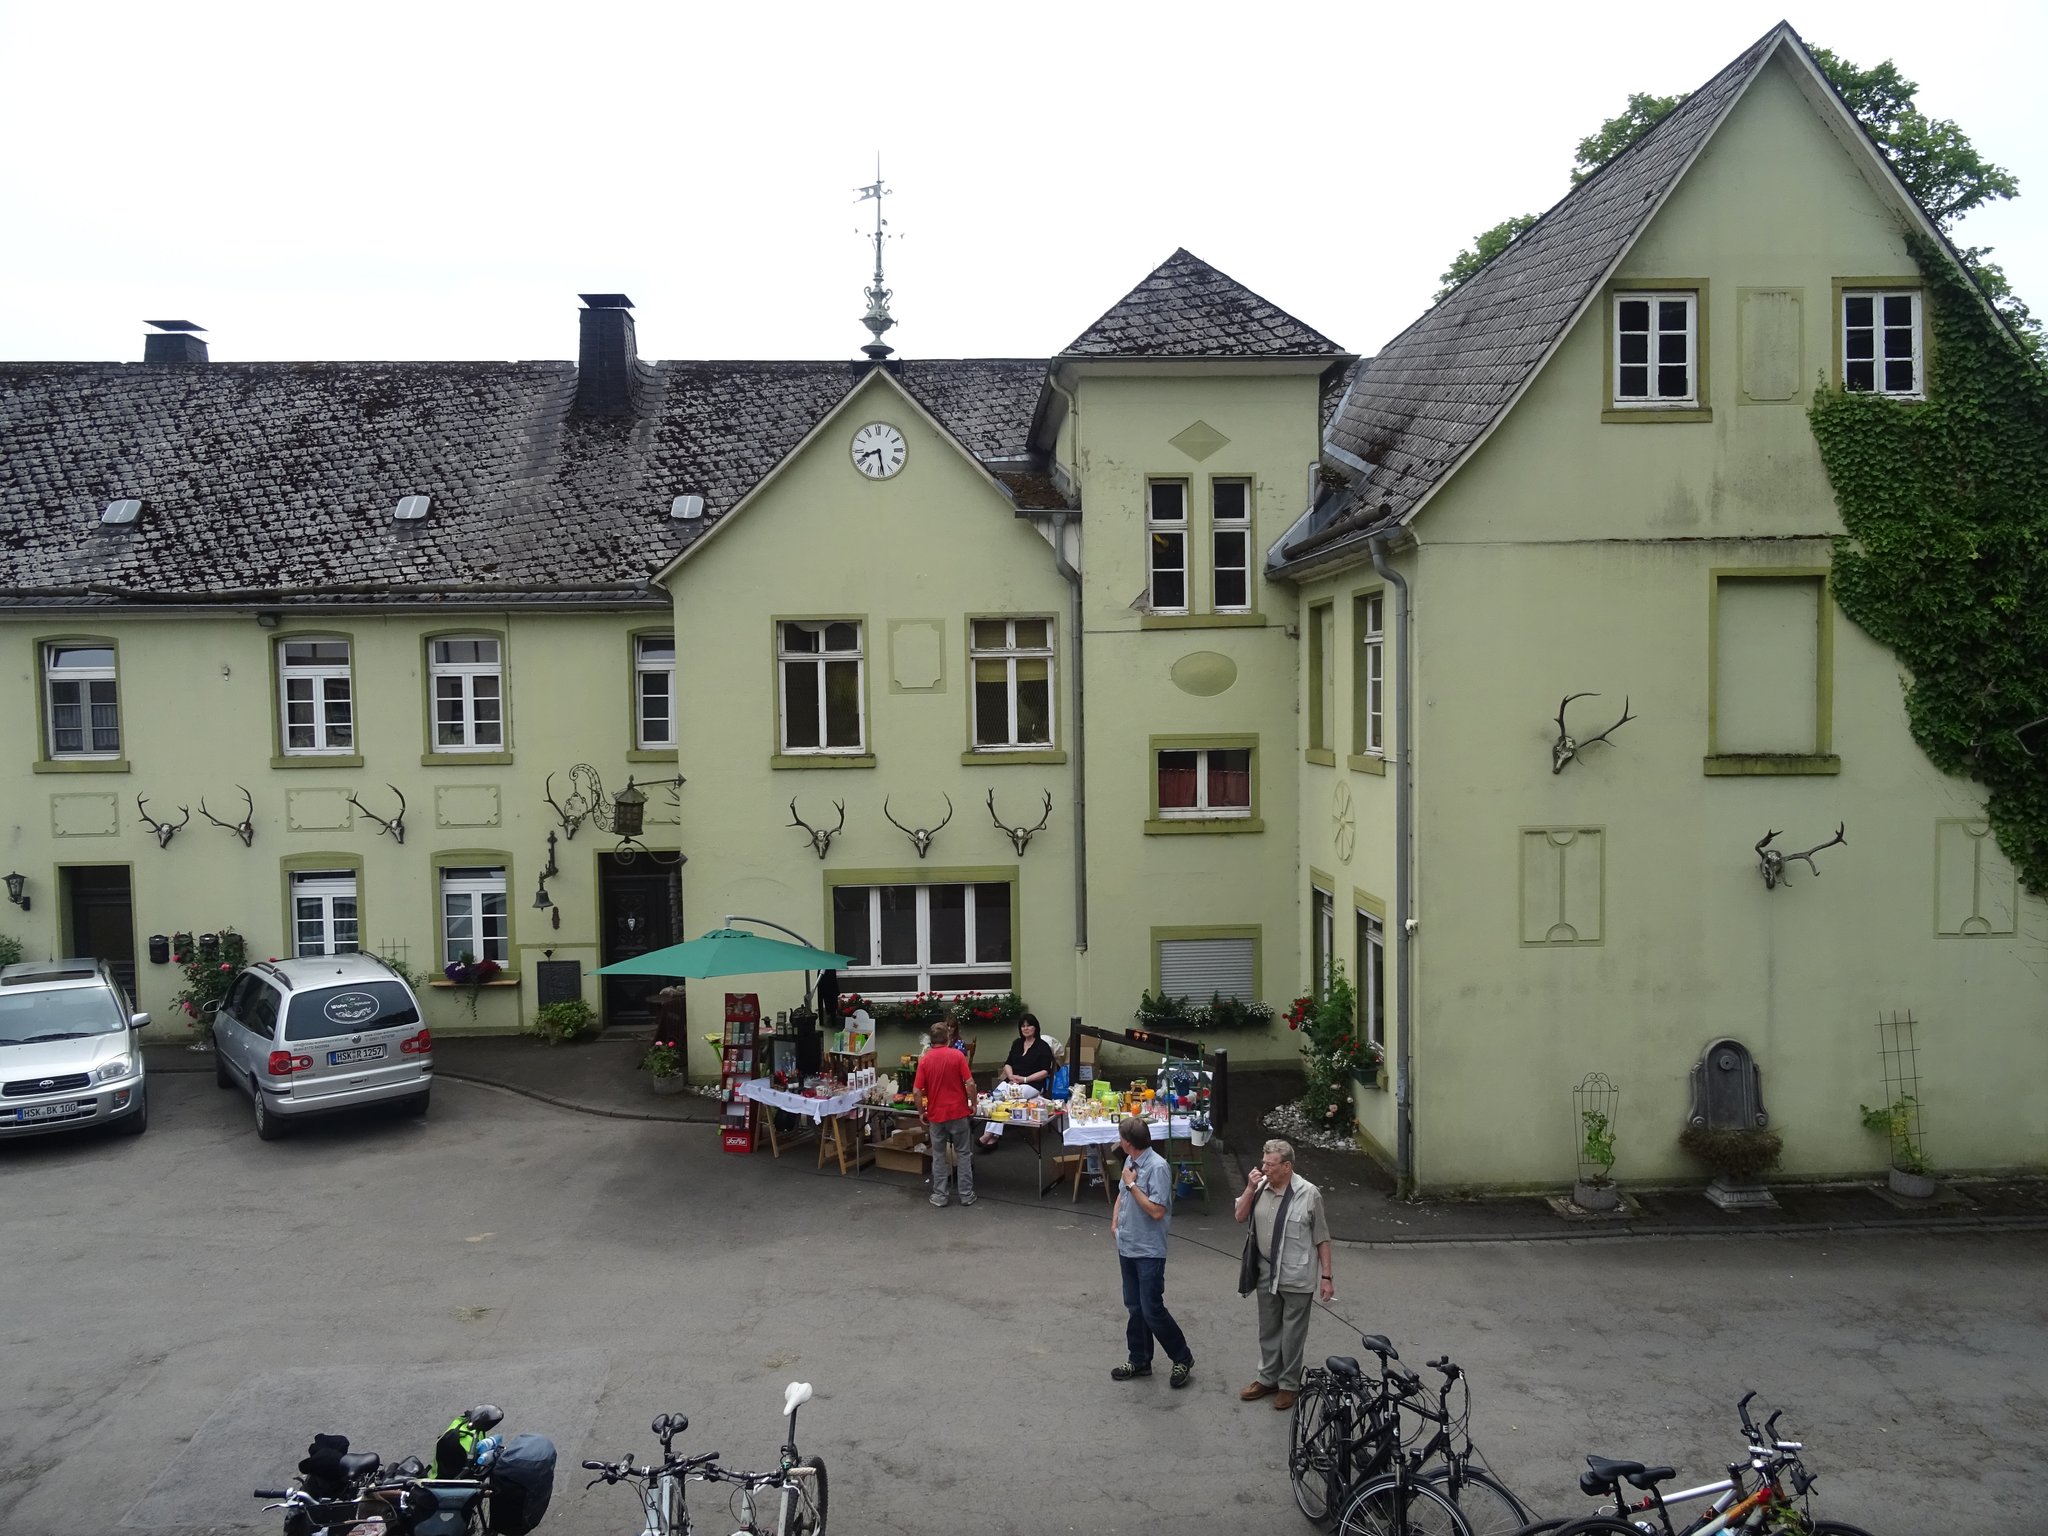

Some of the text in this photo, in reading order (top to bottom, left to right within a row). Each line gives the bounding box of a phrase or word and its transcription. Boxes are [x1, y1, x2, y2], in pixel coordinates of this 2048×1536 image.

[337, 1047, 381, 1061] HSK R 1257
[24, 1103, 76, 1117] HSK BK 100
